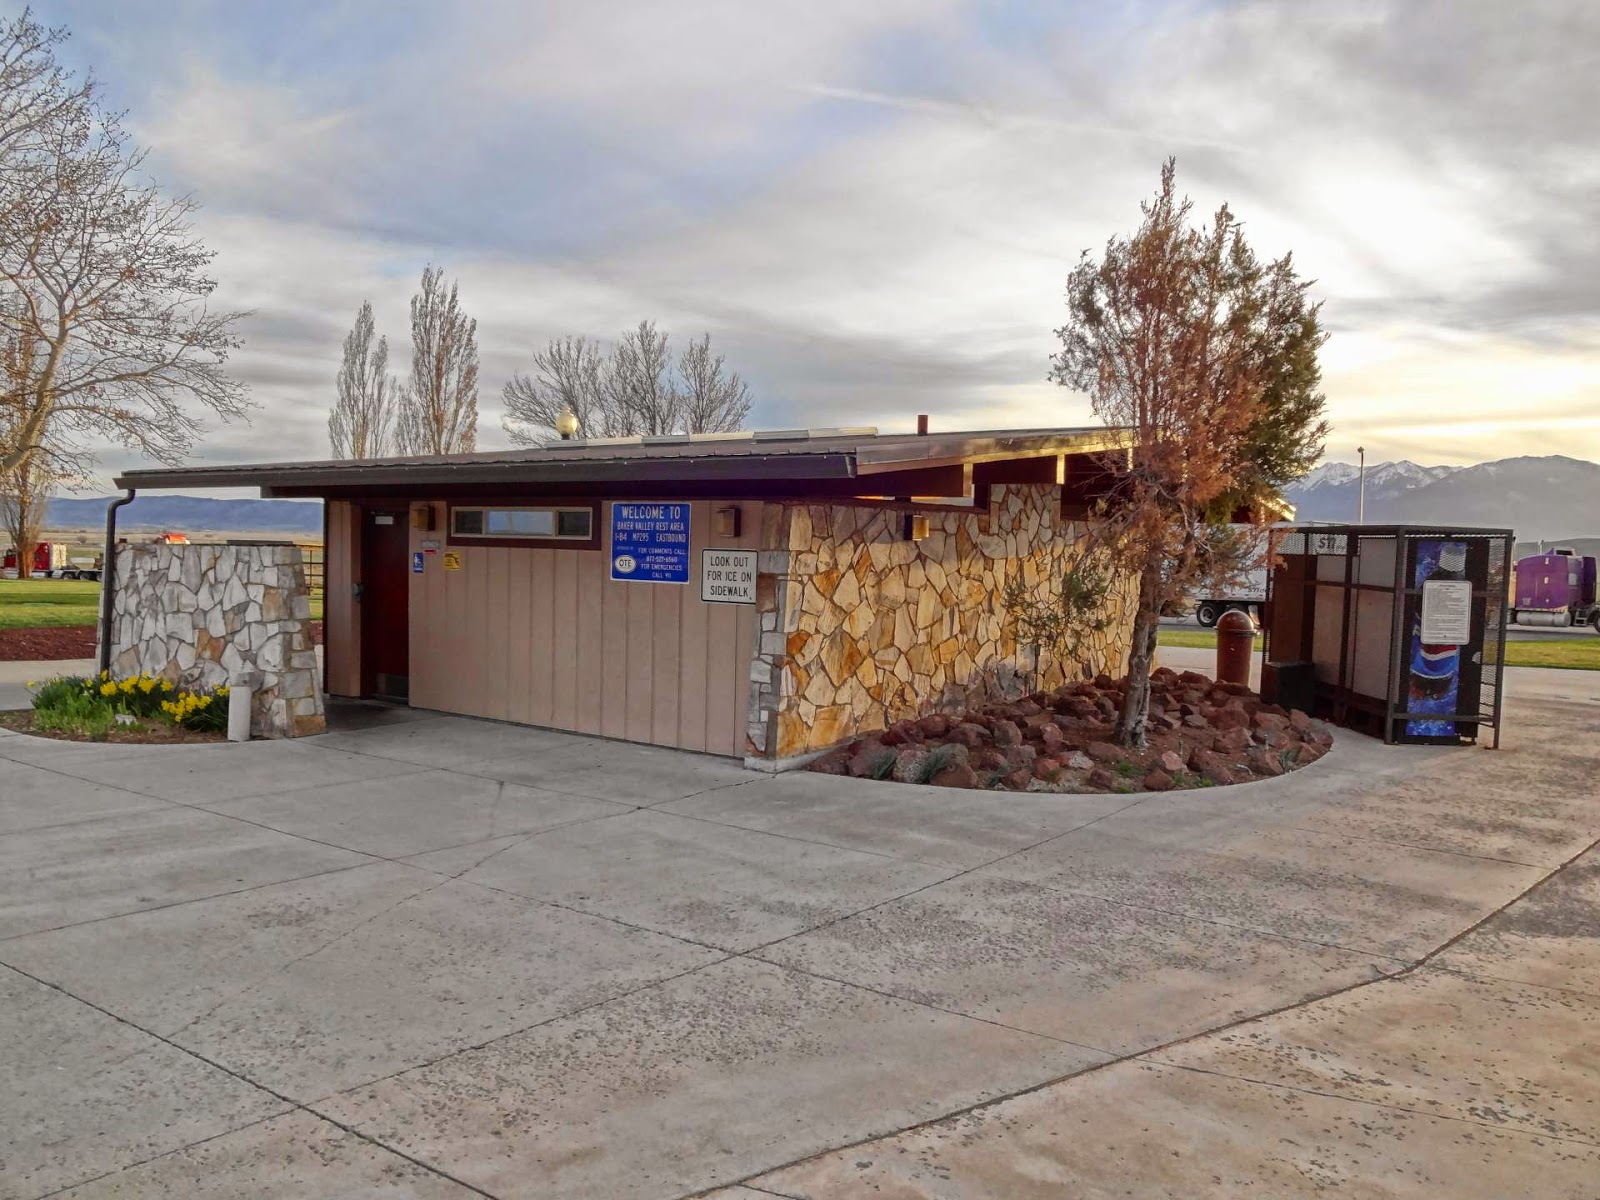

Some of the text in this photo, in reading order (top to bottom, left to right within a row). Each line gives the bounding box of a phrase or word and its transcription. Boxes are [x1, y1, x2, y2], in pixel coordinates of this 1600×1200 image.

[622, 506, 681, 519] WELCOME TO
[617, 522, 684, 531] BAKER VALLEY REST AREA
[632, 533, 649, 542] MP295
[656, 533, 686, 542] EASTBOUND
[619, 559, 632, 567] OTE
[710, 556, 749, 567] LOOK OUT
[707, 570, 752, 582] FOR ICE ON
[710, 585, 749, 597] SIDEWALK
